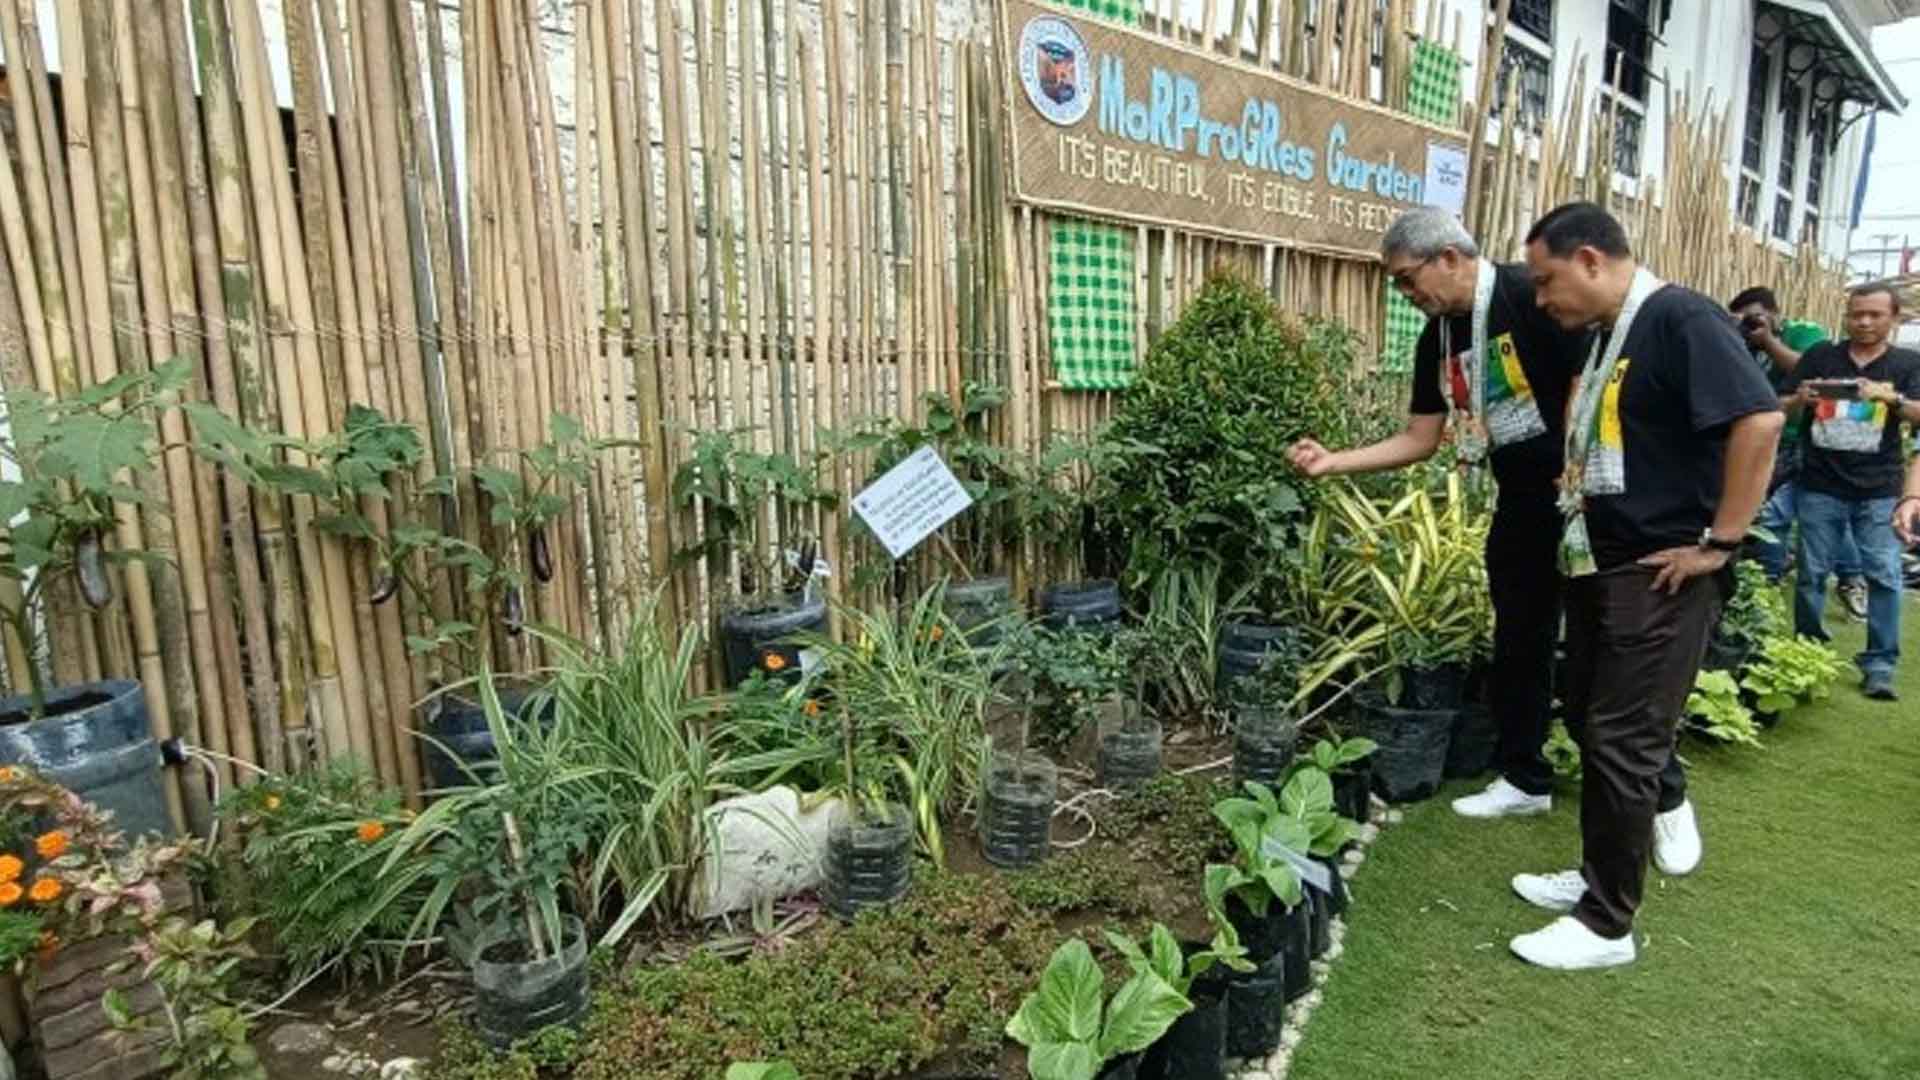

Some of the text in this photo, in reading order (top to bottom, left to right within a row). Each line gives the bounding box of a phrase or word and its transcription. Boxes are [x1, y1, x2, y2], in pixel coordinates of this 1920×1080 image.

[1059, 133, 1096, 178] IT'S
[1098, 54, 1315, 180] MoRProGRes
[1326, 121, 1424, 205] Garden
